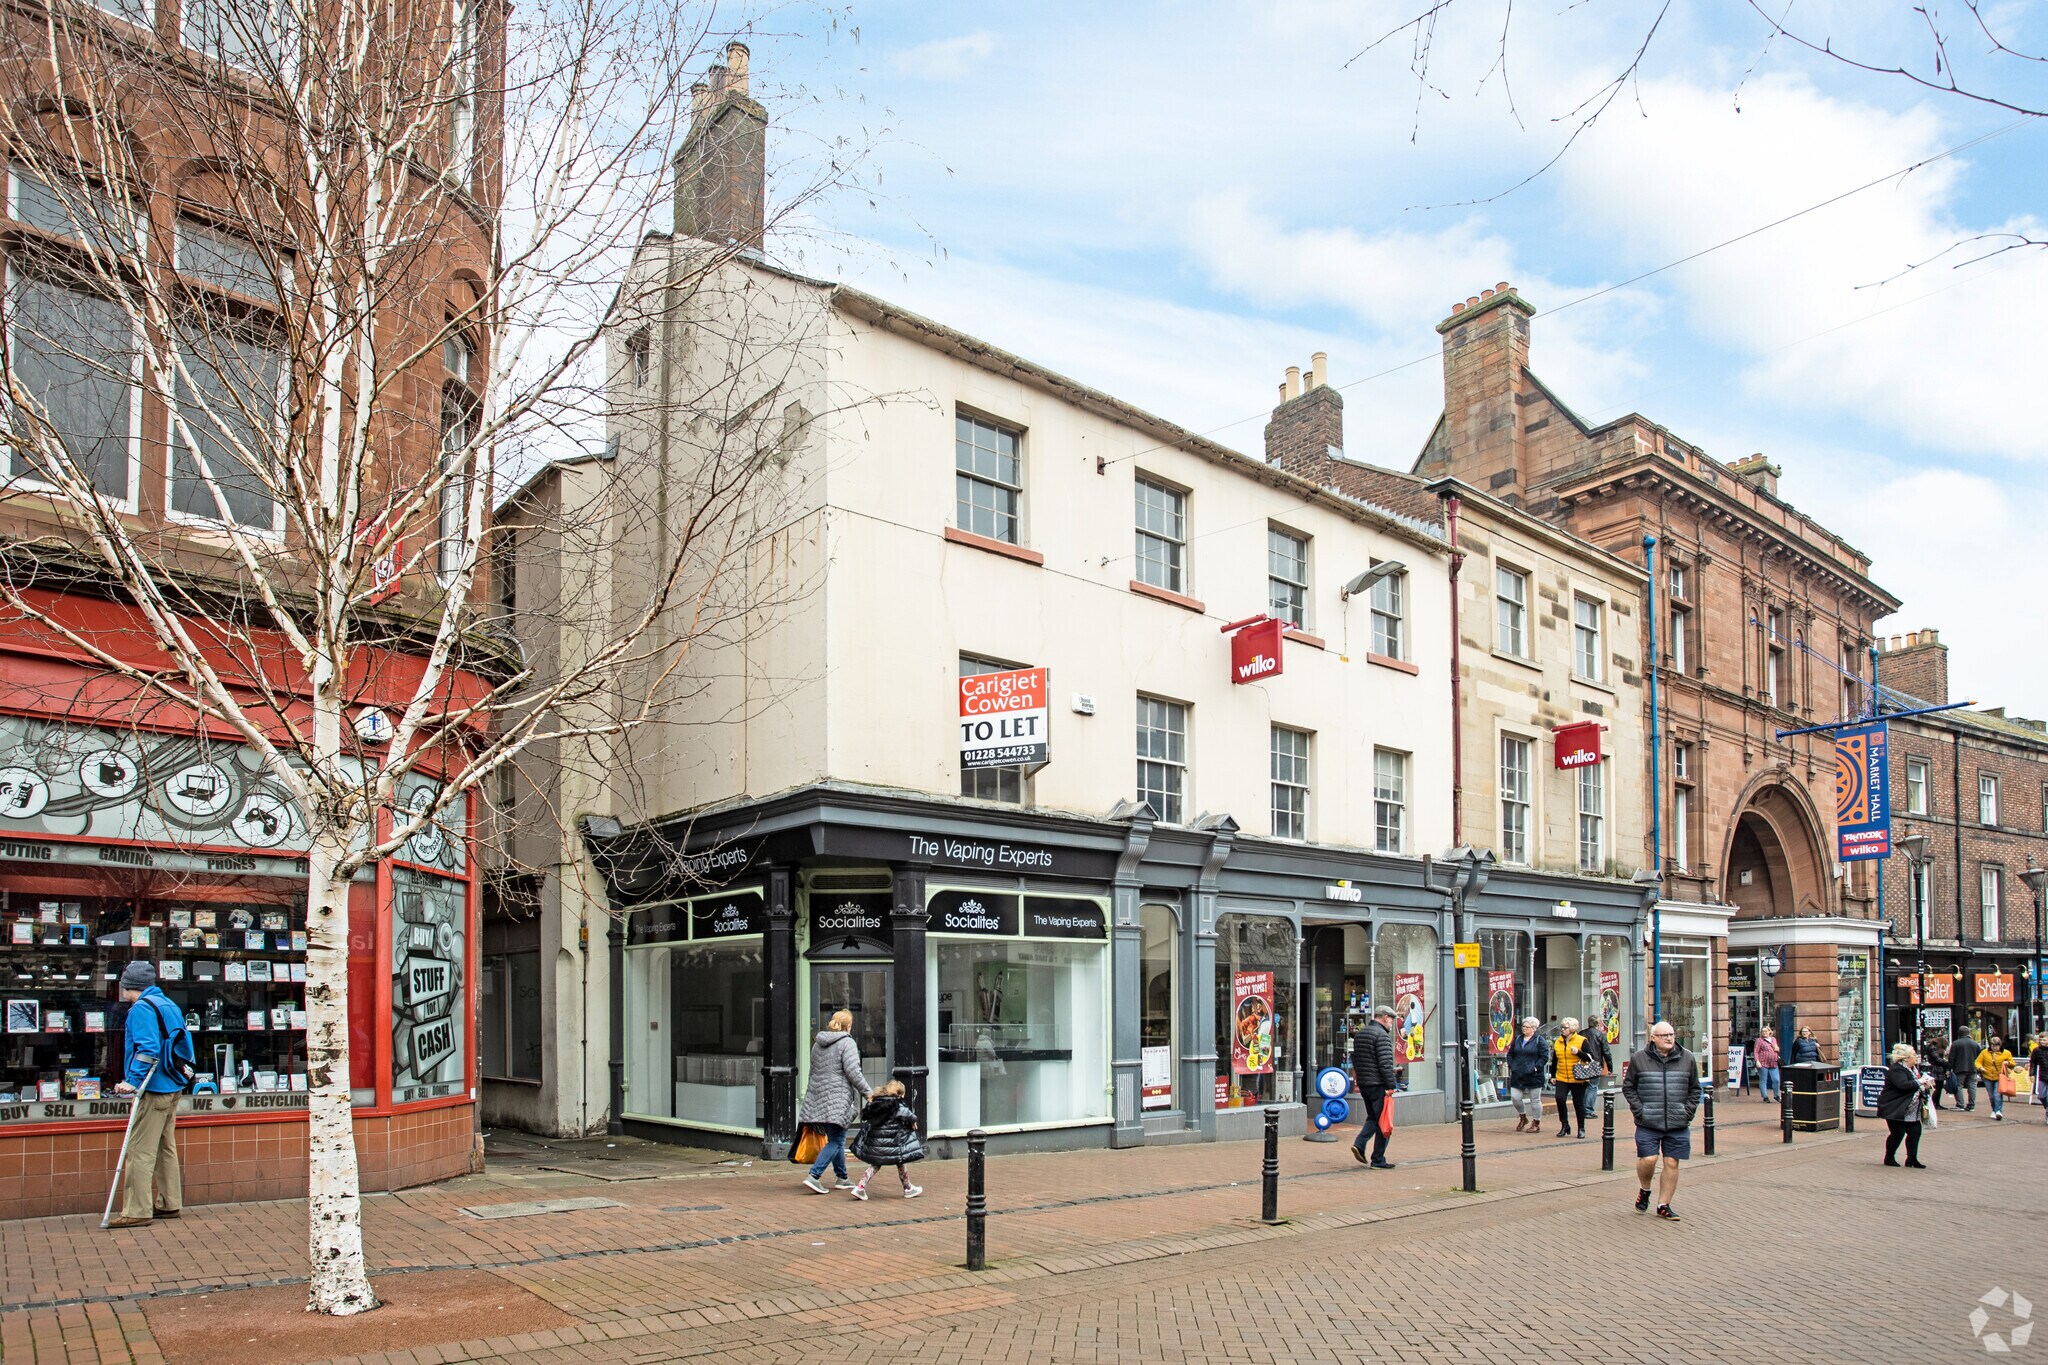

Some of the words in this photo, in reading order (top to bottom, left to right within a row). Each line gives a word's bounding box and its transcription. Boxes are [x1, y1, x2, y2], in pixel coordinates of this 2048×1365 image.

[1239, 655, 1275, 678] wilko
[961, 672, 1037, 697] Carigiet
[965, 693, 1033, 713] Cowen
[961, 721, 993, 742] TO
[1000, 716, 1039, 738] LET
[965, 748, 995, 761] 01228
[997, 745, 1035, 758] 544733
[967, 756, 1031, 766] www.carigietcowen.co.uk
[1562, 749, 1596, 766] wilko
[1870, 747, 1880, 790] MARKET
[1871, 794, 1881, 822] HALL
[99, 847, 154, 867] GAMING
[206, 857, 257, 870] PHONES
[711, 847, 748, 869] Experts
[909, 835, 939, 857] The
[944, 839, 995, 865] Vaping
[999, 845, 1053, 867] Experts
[1850, 845, 1878, 855] wilko
[1325, 880, 1362, 902] wilko
[714, 918, 749, 933] Socialites
[818, 914, 882, 929] Socialites
[945, 913, 999, 930] Socialites
[1033, 915, 1047, 926] The
[1048, 916, 1071, 928] Vaping
[1072, 917, 1097, 928] Experts
[414, 926, 430, 947] BUY
[413, 966, 445, 994] STUFF
[1899, 977, 1927, 986] Sheltr
[1977, 978, 2011, 999] Shelter
[426, 1001, 437, 1016] for
[418, 1022, 450, 1061] CASH
[0, 1105, 30, 1121] BUY
[44, 1104, 76, 1118] SELL
[89, 1102, 132, 1115] DONAT
[192, 1098, 213, 1111] WE
[246, 1095, 309, 1108] RECYCLING
